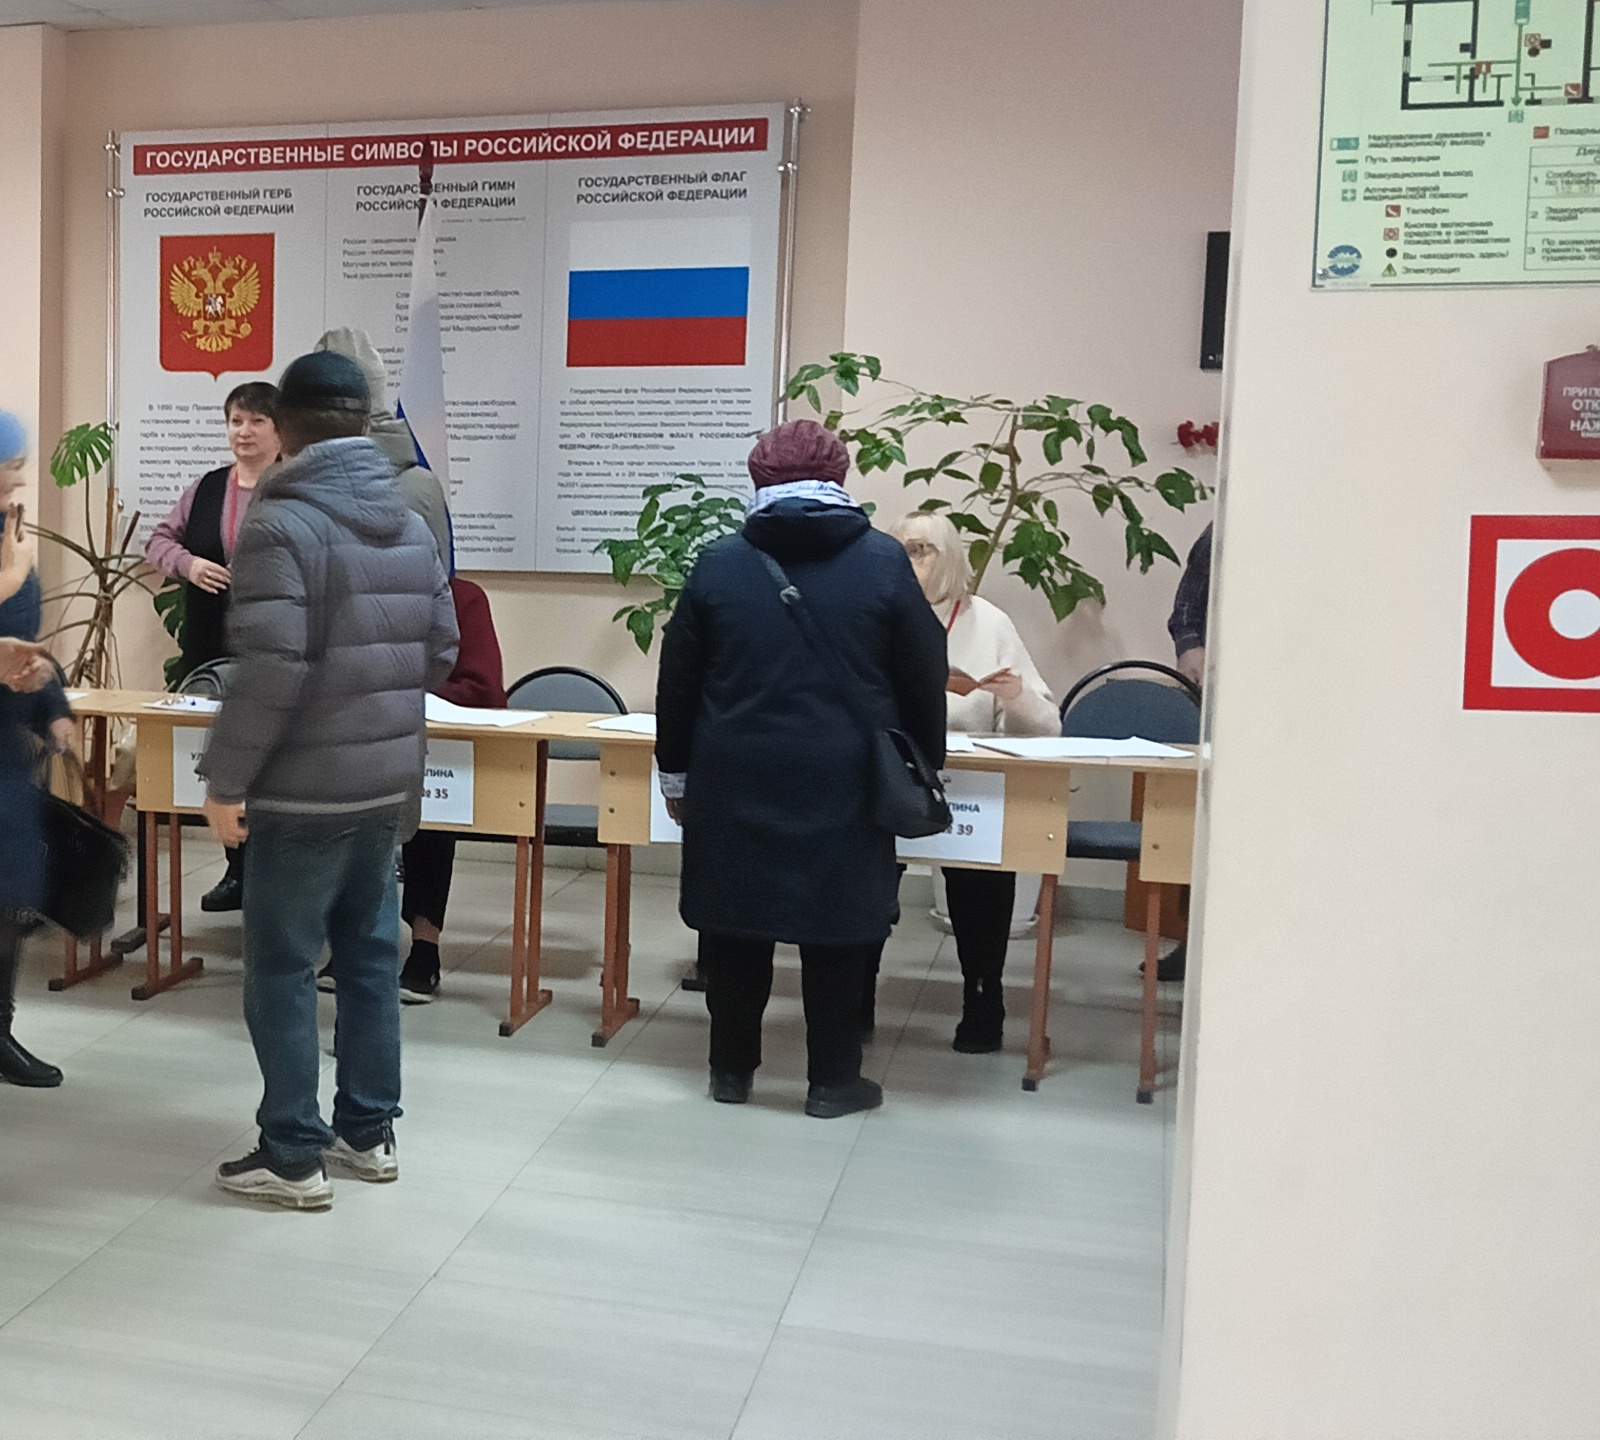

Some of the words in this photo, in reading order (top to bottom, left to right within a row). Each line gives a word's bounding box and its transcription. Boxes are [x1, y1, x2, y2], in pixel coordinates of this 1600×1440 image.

[146, 144, 345, 170] ГОСУДАРСТВЕННЫЕ
[464, 130, 612, 156] РОССИЙСКОЙ
[617, 127, 755, 151] ФЕДЕРАЦИИ
[578, 171, 709, 188] ГОСУДАРСТВЕННЫЙ
[710, 170, 747, 184] ФЛАГ
[145, 188, 261, 204] ГОСУДАРСТВЕННЫЙ
[263, 187, 293, 201] ГЕРБ
[356, 180, 479, 197] ГОСУДАРСЕННЫЙ
[482, 180, 516, 192] ГИМН
[576, 189, 665, 204] РОССИЙСКОЙ
[667, 187, 748, 203] ФЕДЕРАЦИИ
[143, 204, 222, 218] РОССИЙСКОЙ
[223, 203, 294, 217] ФЕДЕРАЦИИ
[355, 197, 438, 212] РОССИЙСК
[440, 196, 516, 210] ФЕДЕРАЦИИ
[1562, 386, 1588, 397] ПРИ
[1571, 398, 1600, 411] ОТК
[424, 768, 455, 779] ПИНА
[434, 788, 449, 800] 35
[948, 802, 981, 813] ПИНА
[956, 823, 974, 836] 39
